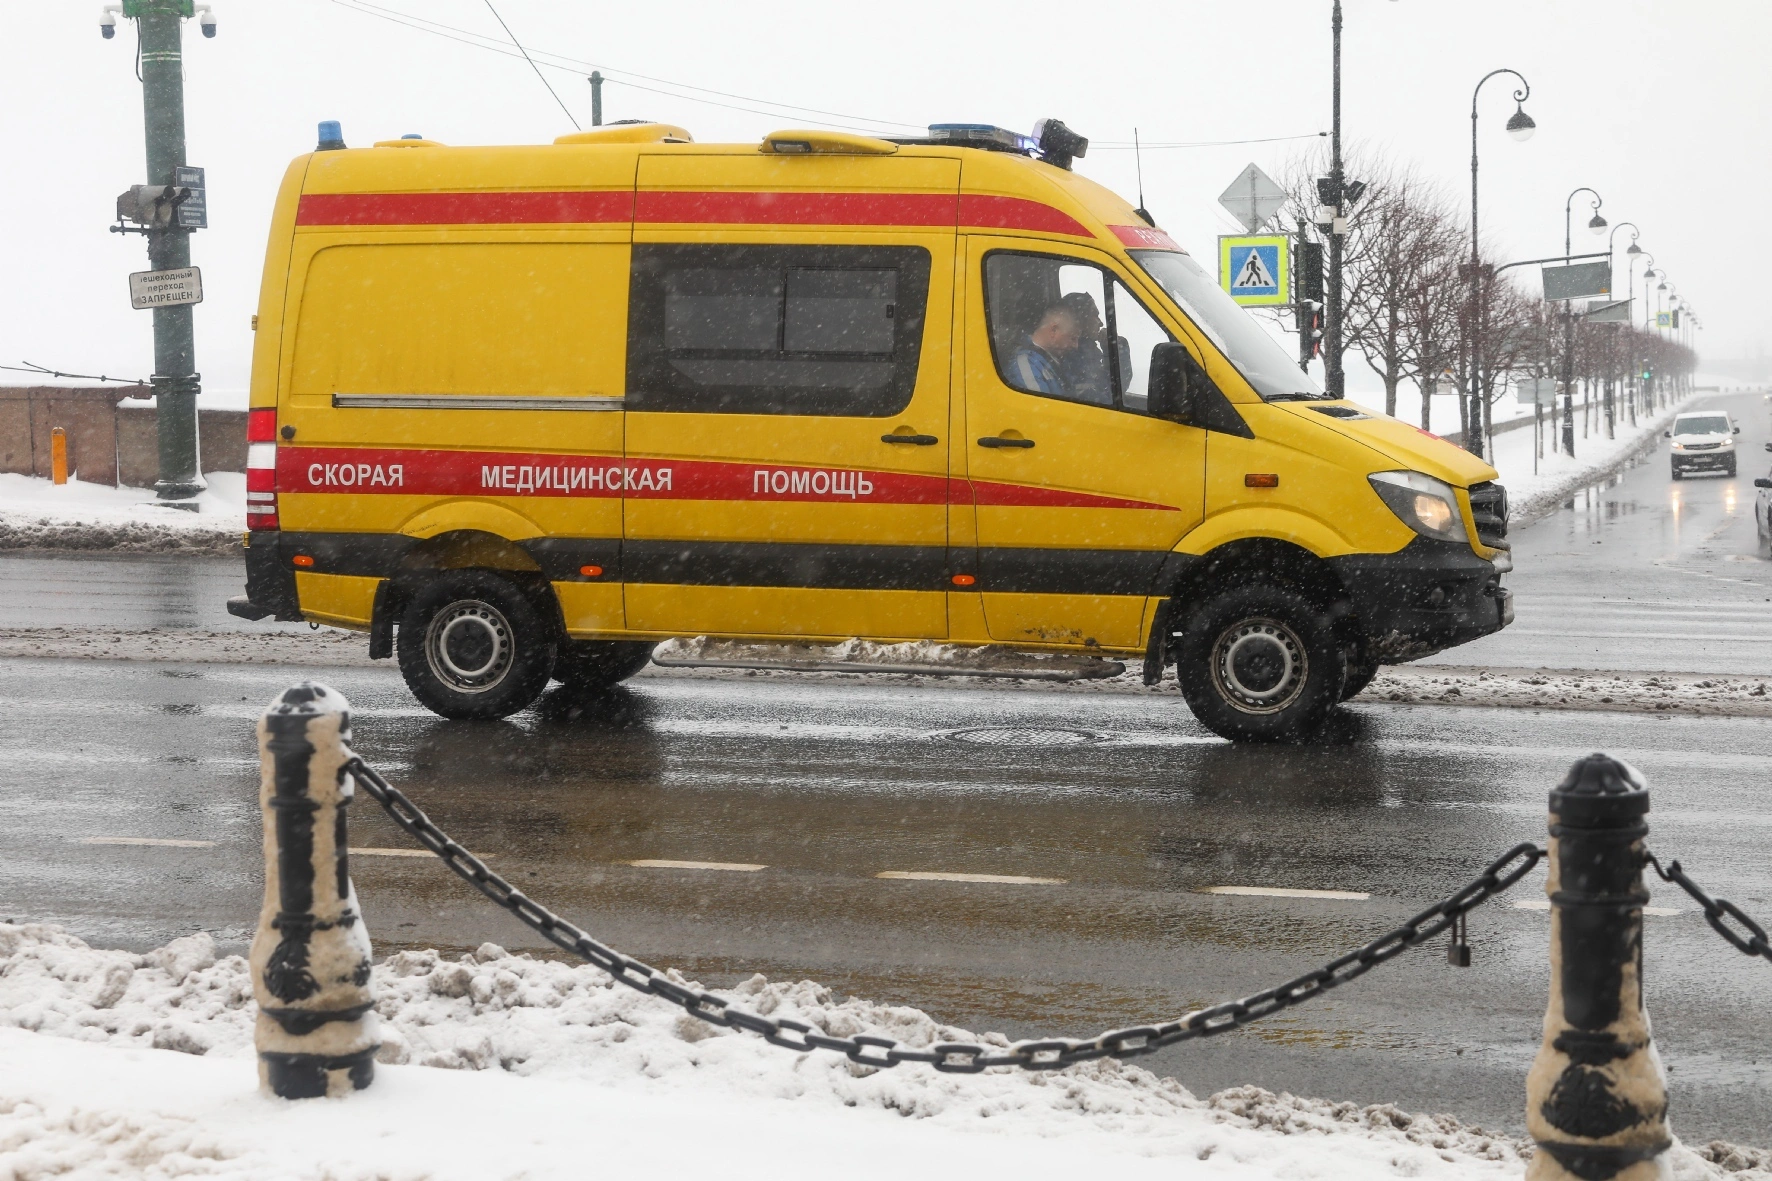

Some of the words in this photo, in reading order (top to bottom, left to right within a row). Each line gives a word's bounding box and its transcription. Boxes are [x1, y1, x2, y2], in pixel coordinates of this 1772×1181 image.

[140, 270, 193, 283] ешеходный
[147, 282, 185, 293] переход
[141, 291, 193, 304] ЗАПРЕЩЕН
[307, 463, 403, 487] СКОРАЯ
[481, 465, 673, 493] МЕДИЦИНСКАЯ
[753, 470, 874, 499] ПОМОЩЬ
